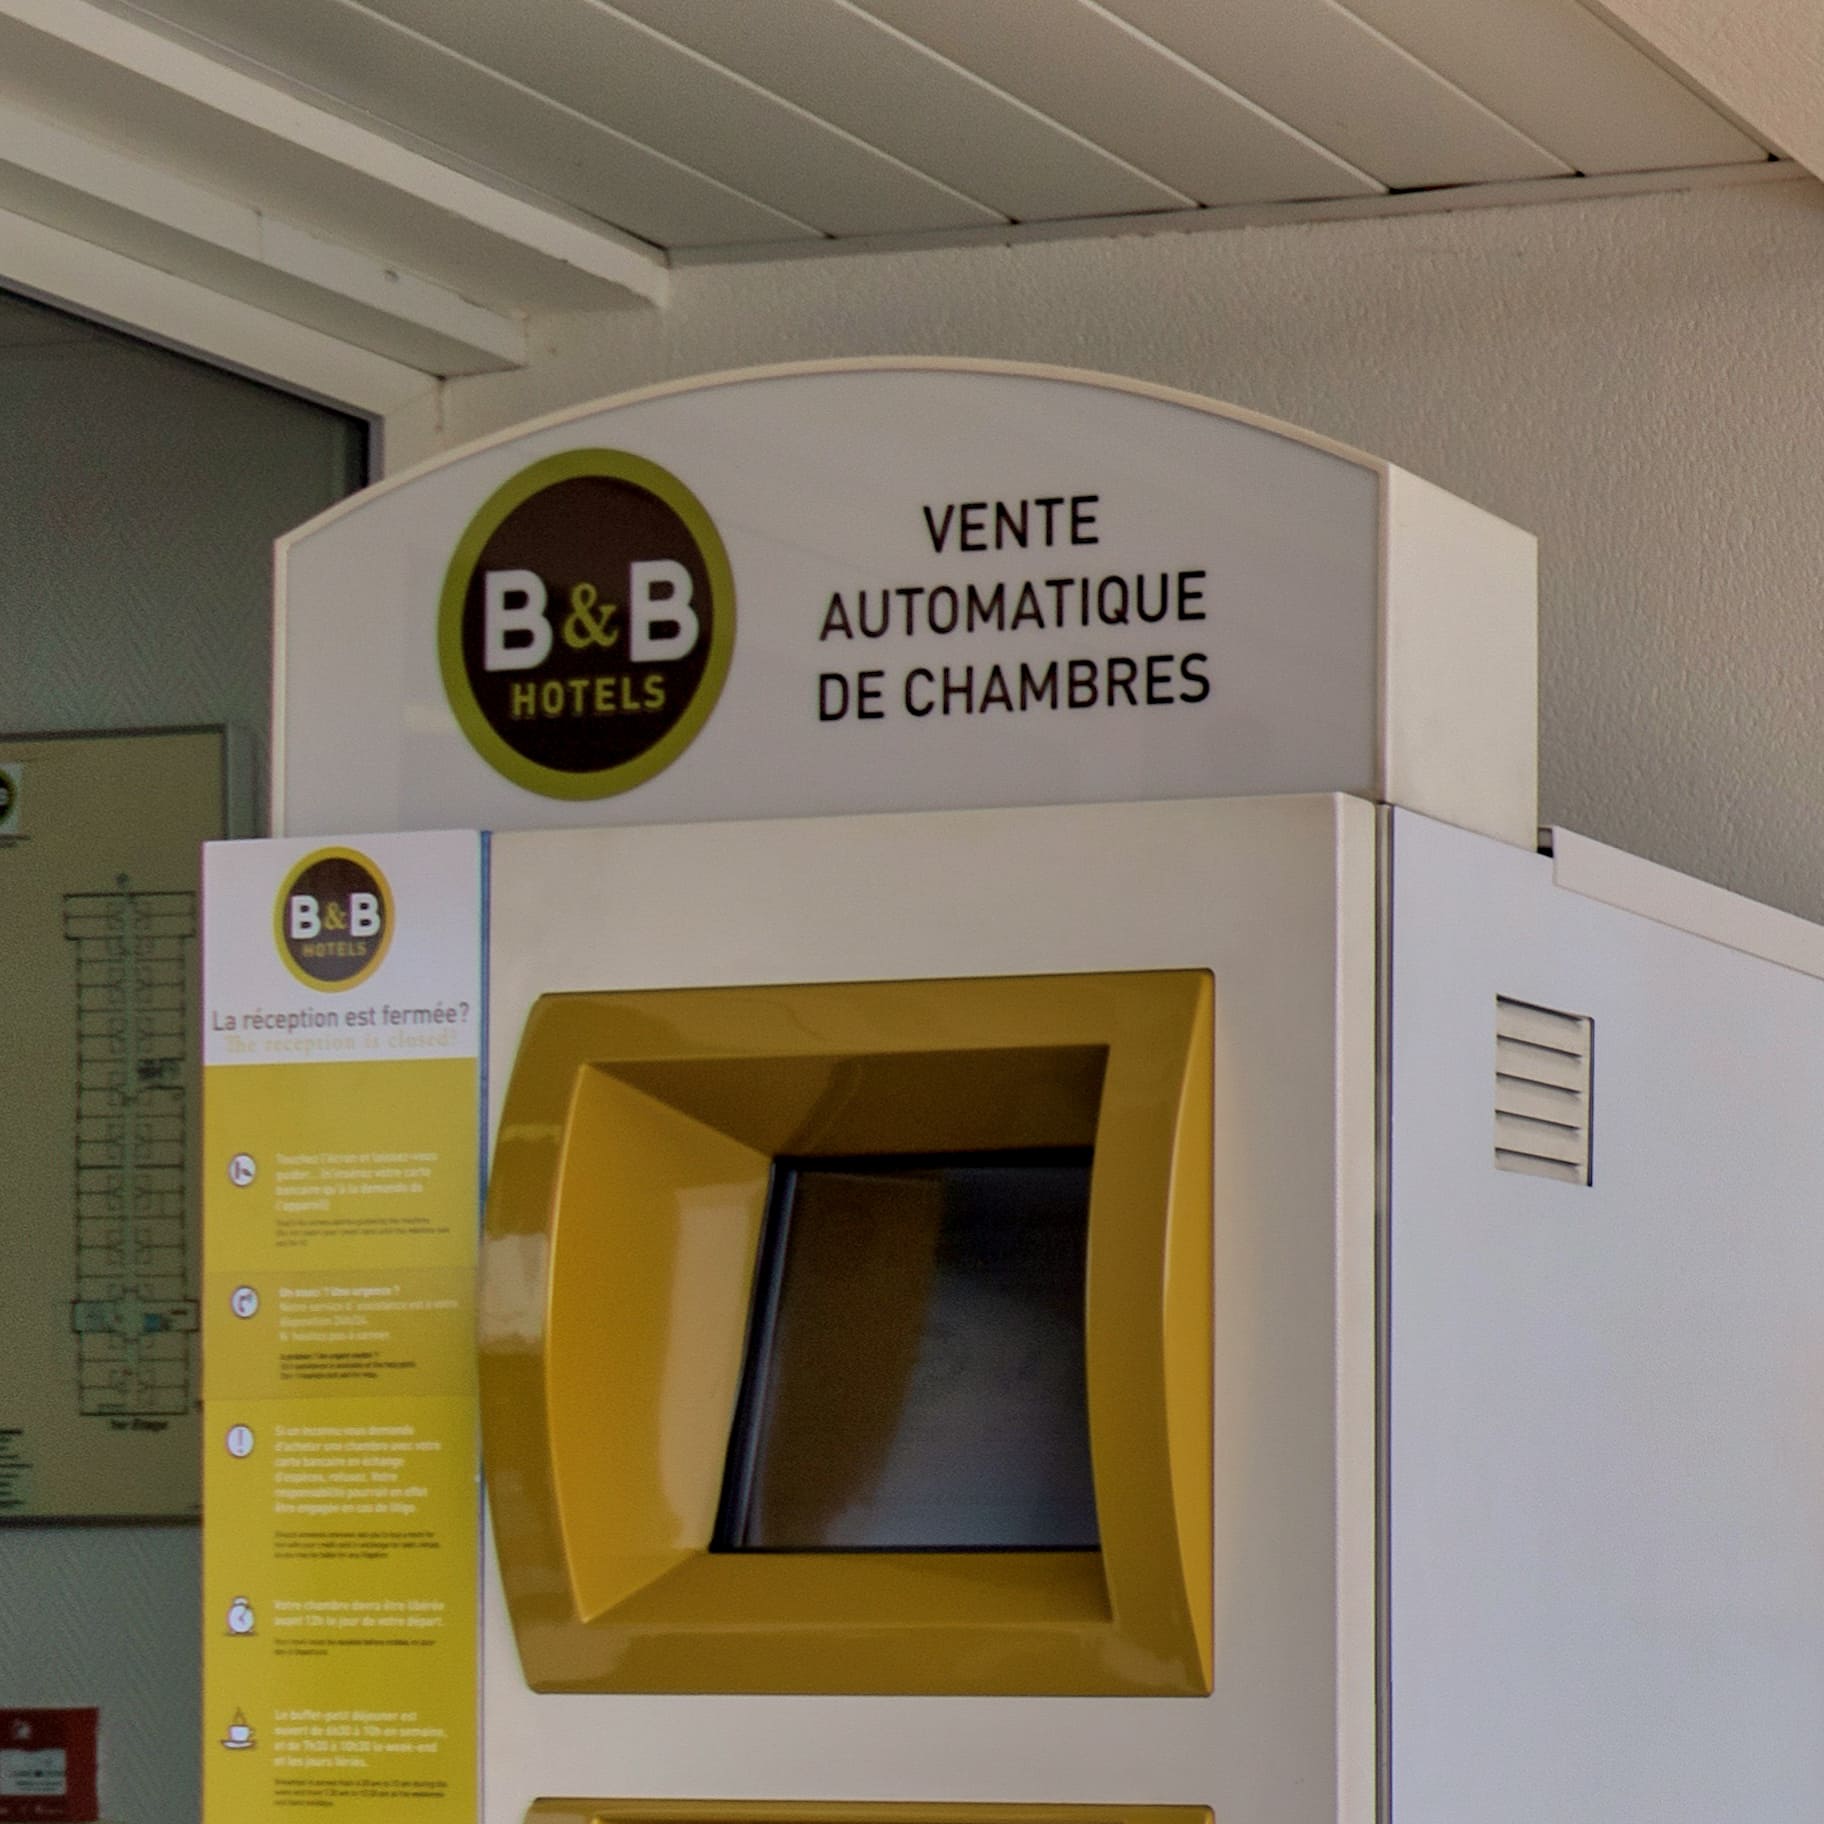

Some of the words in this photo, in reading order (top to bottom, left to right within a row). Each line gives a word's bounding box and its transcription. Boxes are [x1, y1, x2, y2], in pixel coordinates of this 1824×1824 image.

[923, 495, 1100, 553] VENTE
[483, 559, 701, 673] B&B
[819, 569, 1207, 642] AUTOMATIQUE
[511, 674, 667, 720] HOTELS
[818, 670, 885, 722] DE
[905, 653, 1212, 716] CHAMBRES
[289, 893, 381, 939] B&B
[302, 941, 368, 958] HOTELS
[212, 1010, 236, 1031] La
[243, 1006, 338, 1033] réception
[346, 1009, 376, 1027] est
[263, 1032, 355, 1055] reception
